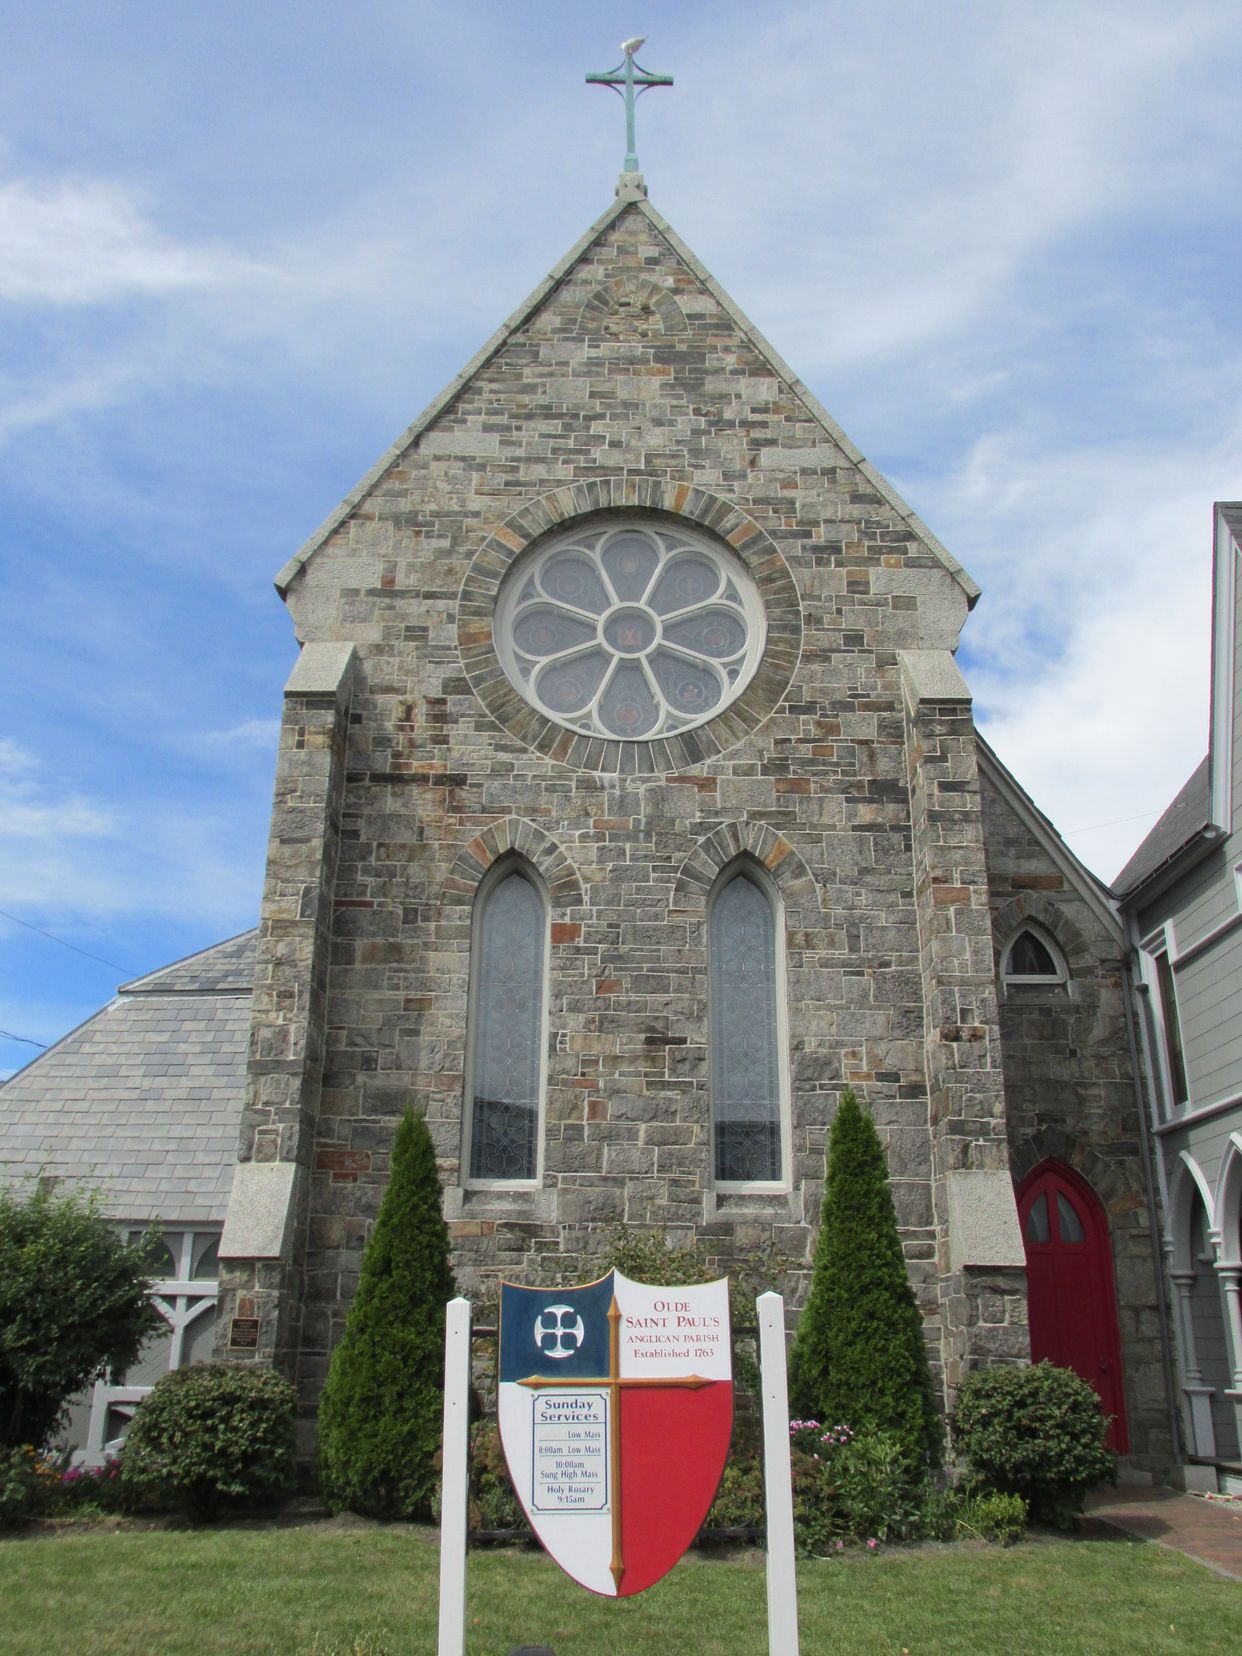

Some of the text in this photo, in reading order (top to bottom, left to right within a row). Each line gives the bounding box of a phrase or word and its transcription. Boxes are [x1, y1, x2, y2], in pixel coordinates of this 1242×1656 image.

[653, 1300, 691, 1312] OLDE
[626, 1316, 720, 1328] SAINT PAUL'S
[627, 1334, 720, 1344] ANGLICAN PARISH
[634, 1348, 714, 1358] Established 1763
[545, 1399, 594, 1412] Sunday
[540, 1411, 598, 1422] Services
[568, 1430, 601, 1439] Low Mass
[538, 1446, 601, 1454] 8:00am Low Mass
[555, 1461, 585, 1469] 10:00am
[540, 1470, 598, 1480] Sung High Mass
[547, 1485, 594, 1494] Holy Rosary
[557, 1495, 585, 1503] 9:15am
